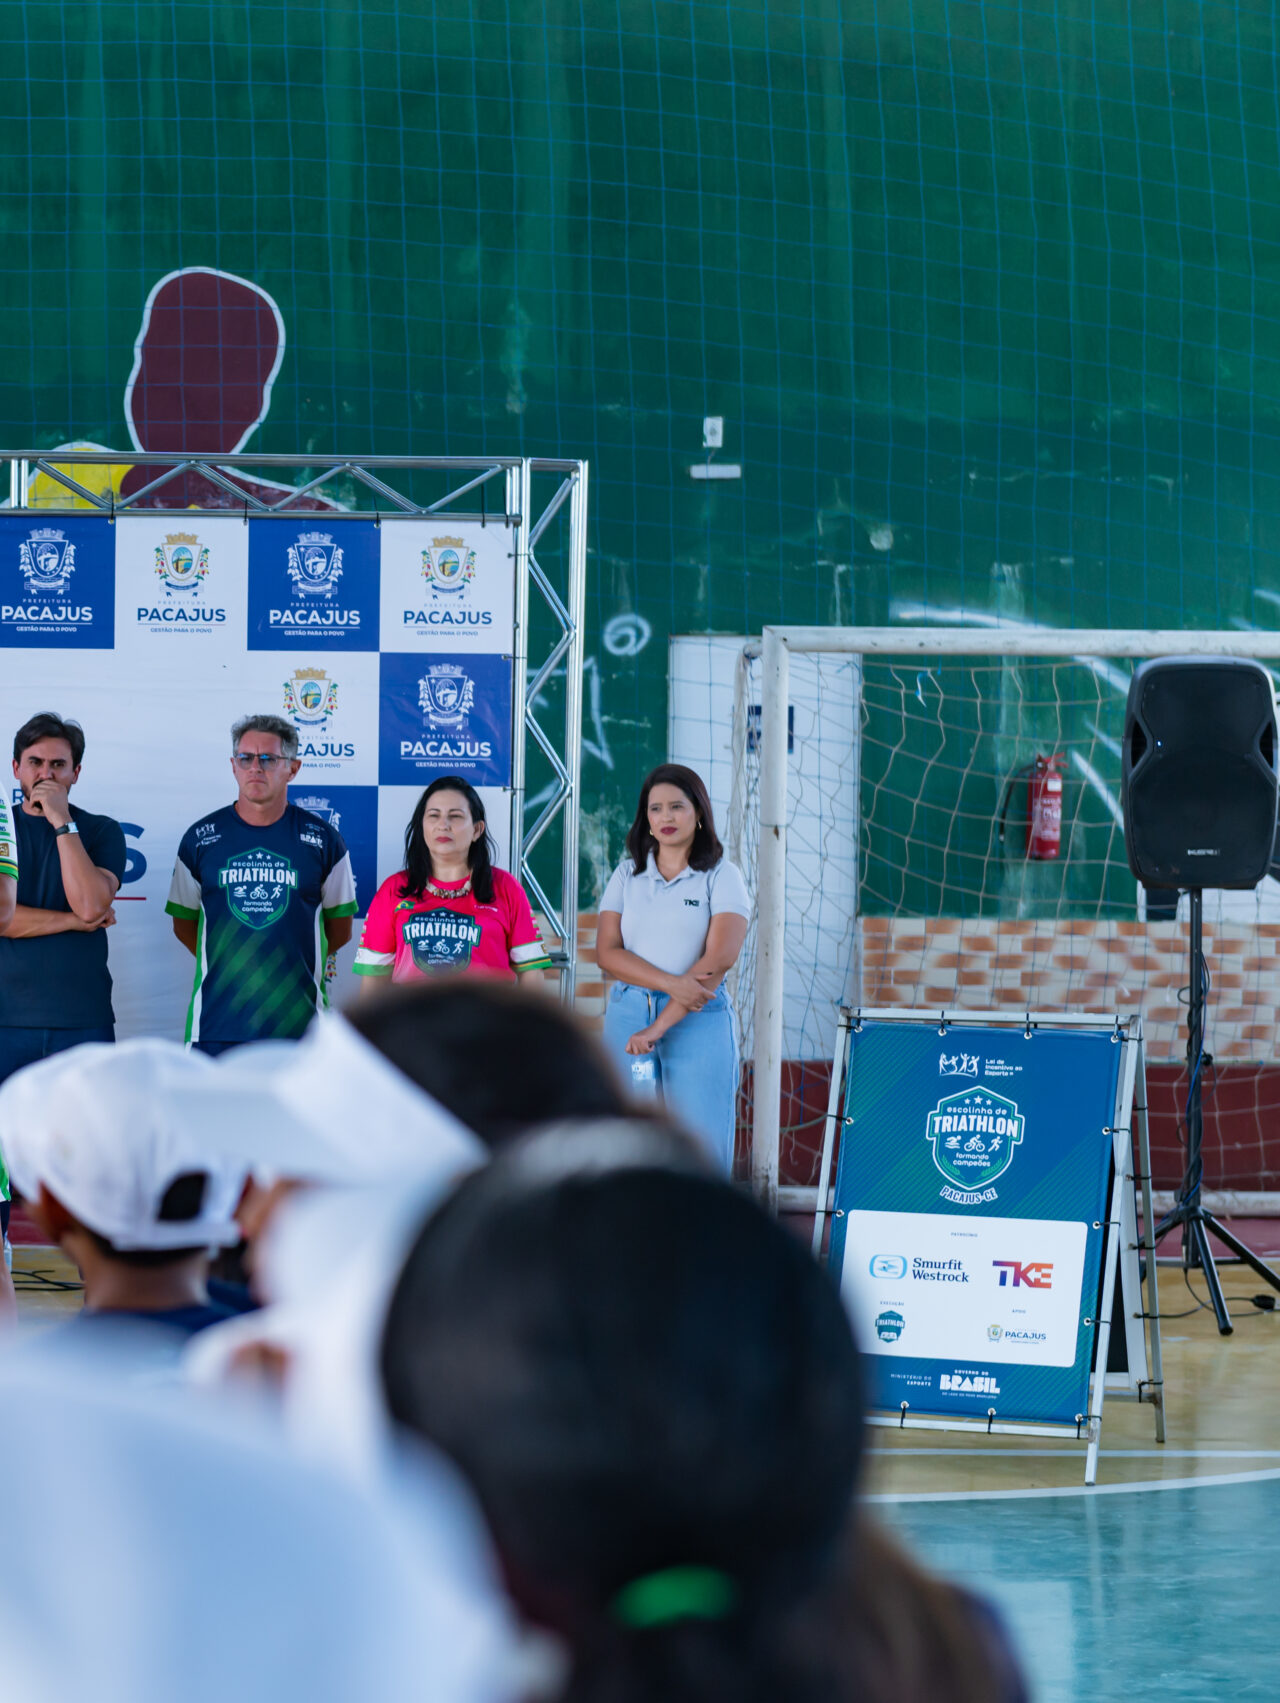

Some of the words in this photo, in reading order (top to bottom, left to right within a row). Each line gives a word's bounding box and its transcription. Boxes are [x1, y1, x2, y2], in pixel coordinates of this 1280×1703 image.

[2, 606, 92, 621] PACAJUS
[138, 608, 226, 621] PACAJUS
[270, 610, 360, 625] PACAJUS
[404, 611, 492, 624] PACAJUS
[296, 744, 354, 756] AJUS
[401, 742, 491, 756] PACAJUS
[222, 868, 296, 886] TRIATHLON
[405, 922, 478, 943] TRIATHLON
[947, 1107, 992, 1115] escolinha
[934, 1115, 1018, 1138] TRIATHLON
[940, 1186, 998, 1204] PACAJUS-CE
[913, 1257, 963, 1271] Smurfit
[912, 1269, 969, 1282] Westrock
[992, 1260, 1054, 1288] TKE
[1005, 1331, 1046, 1340] PACAJUS
[940, 1374, 1000, 1394] BRASIL
